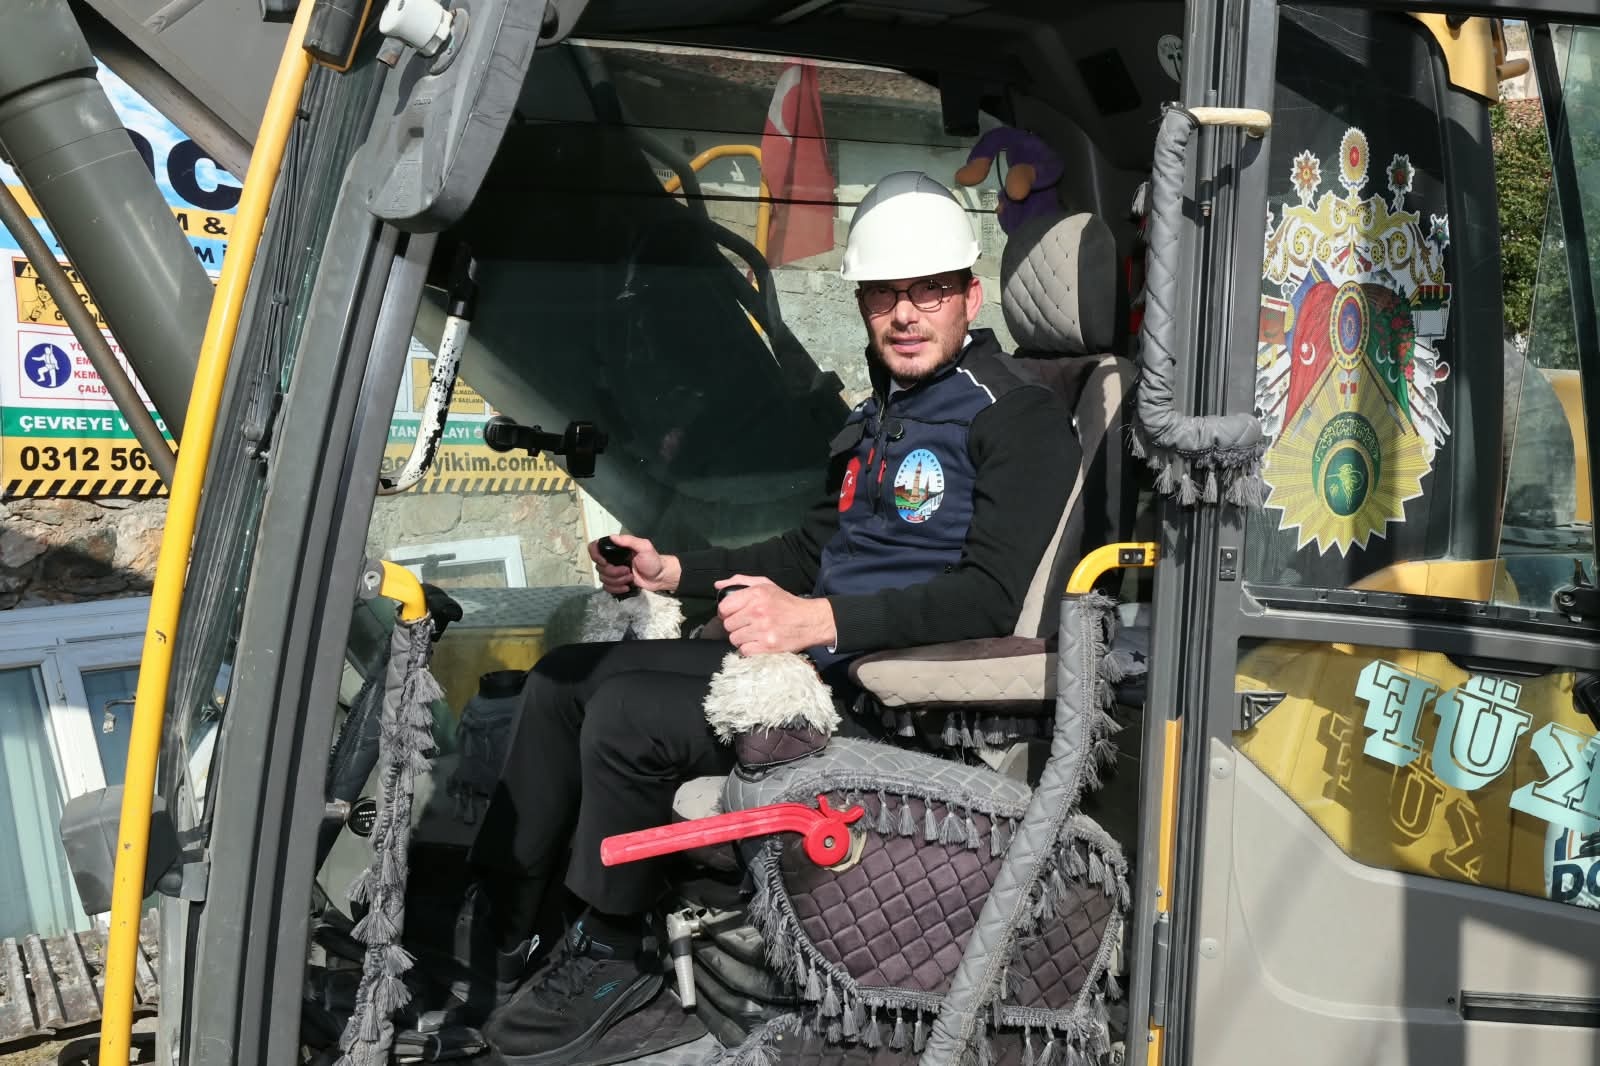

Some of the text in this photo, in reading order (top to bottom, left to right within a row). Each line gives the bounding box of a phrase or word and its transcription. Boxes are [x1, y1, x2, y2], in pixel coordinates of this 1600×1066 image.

[203, 216, 228, 235] &
[19, 416, 113, 432] ÇEVREYE
[20, 446, 100, 471] 0312
